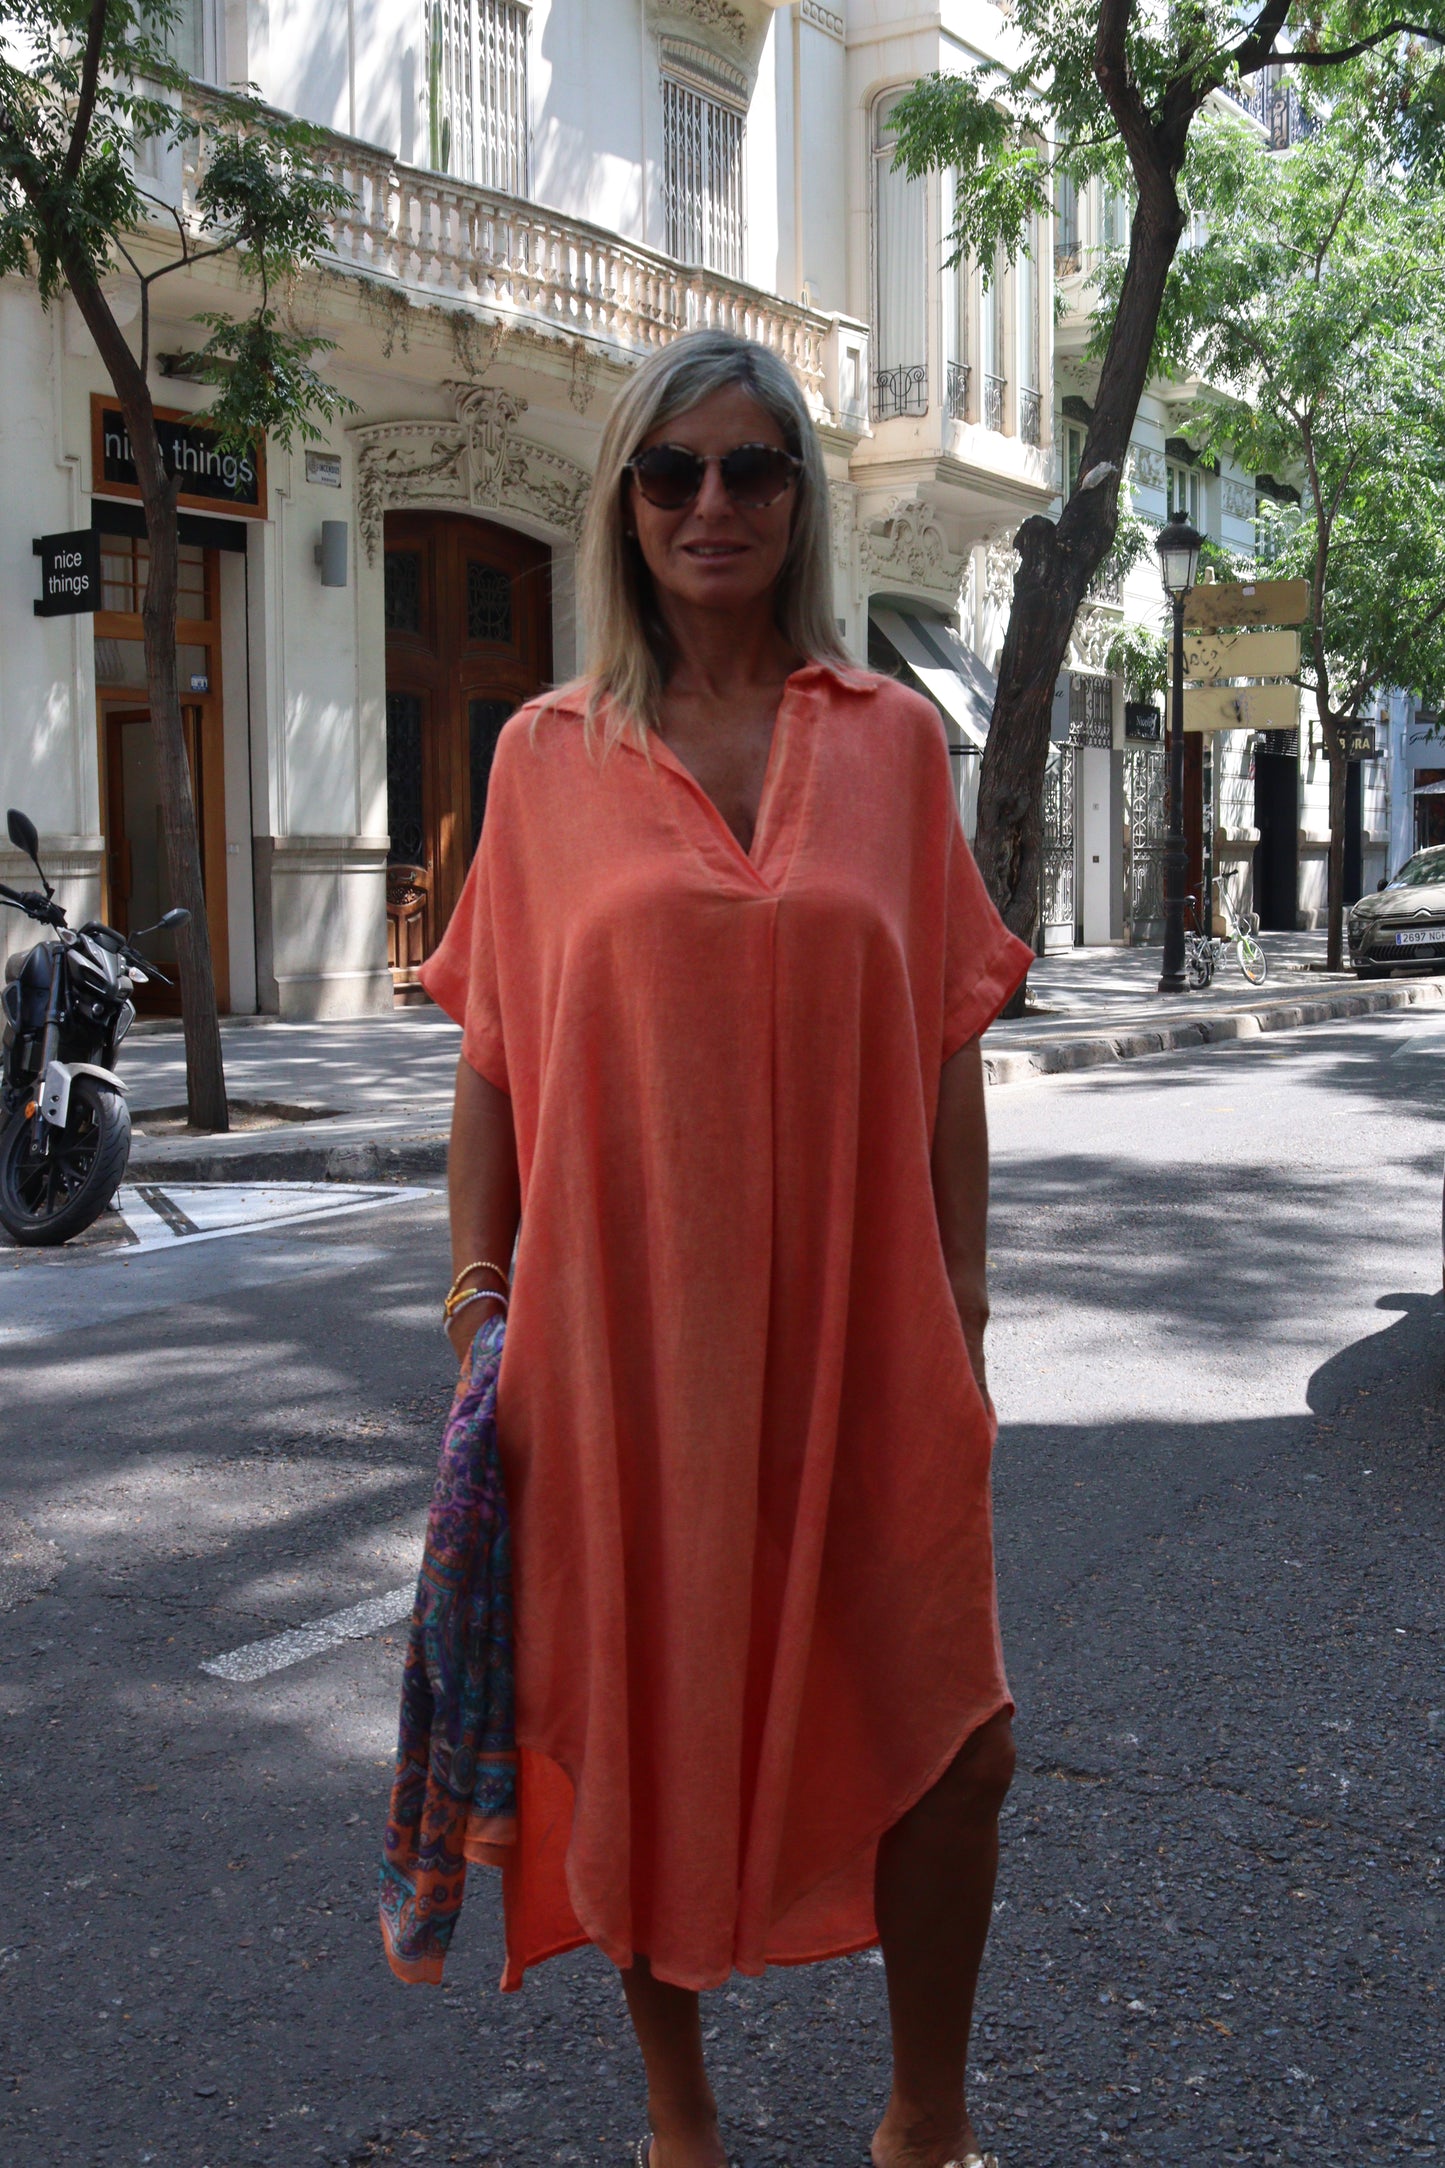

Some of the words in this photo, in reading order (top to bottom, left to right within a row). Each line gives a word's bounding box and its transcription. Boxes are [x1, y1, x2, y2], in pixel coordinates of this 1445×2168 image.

[105, 428, 164, 463] ni
[172, 439, 253, 488] things
[54, 550, 82, 570] nice
[49, 573, 89, 596] things
[1402, 932, 1426, 943] 2697
